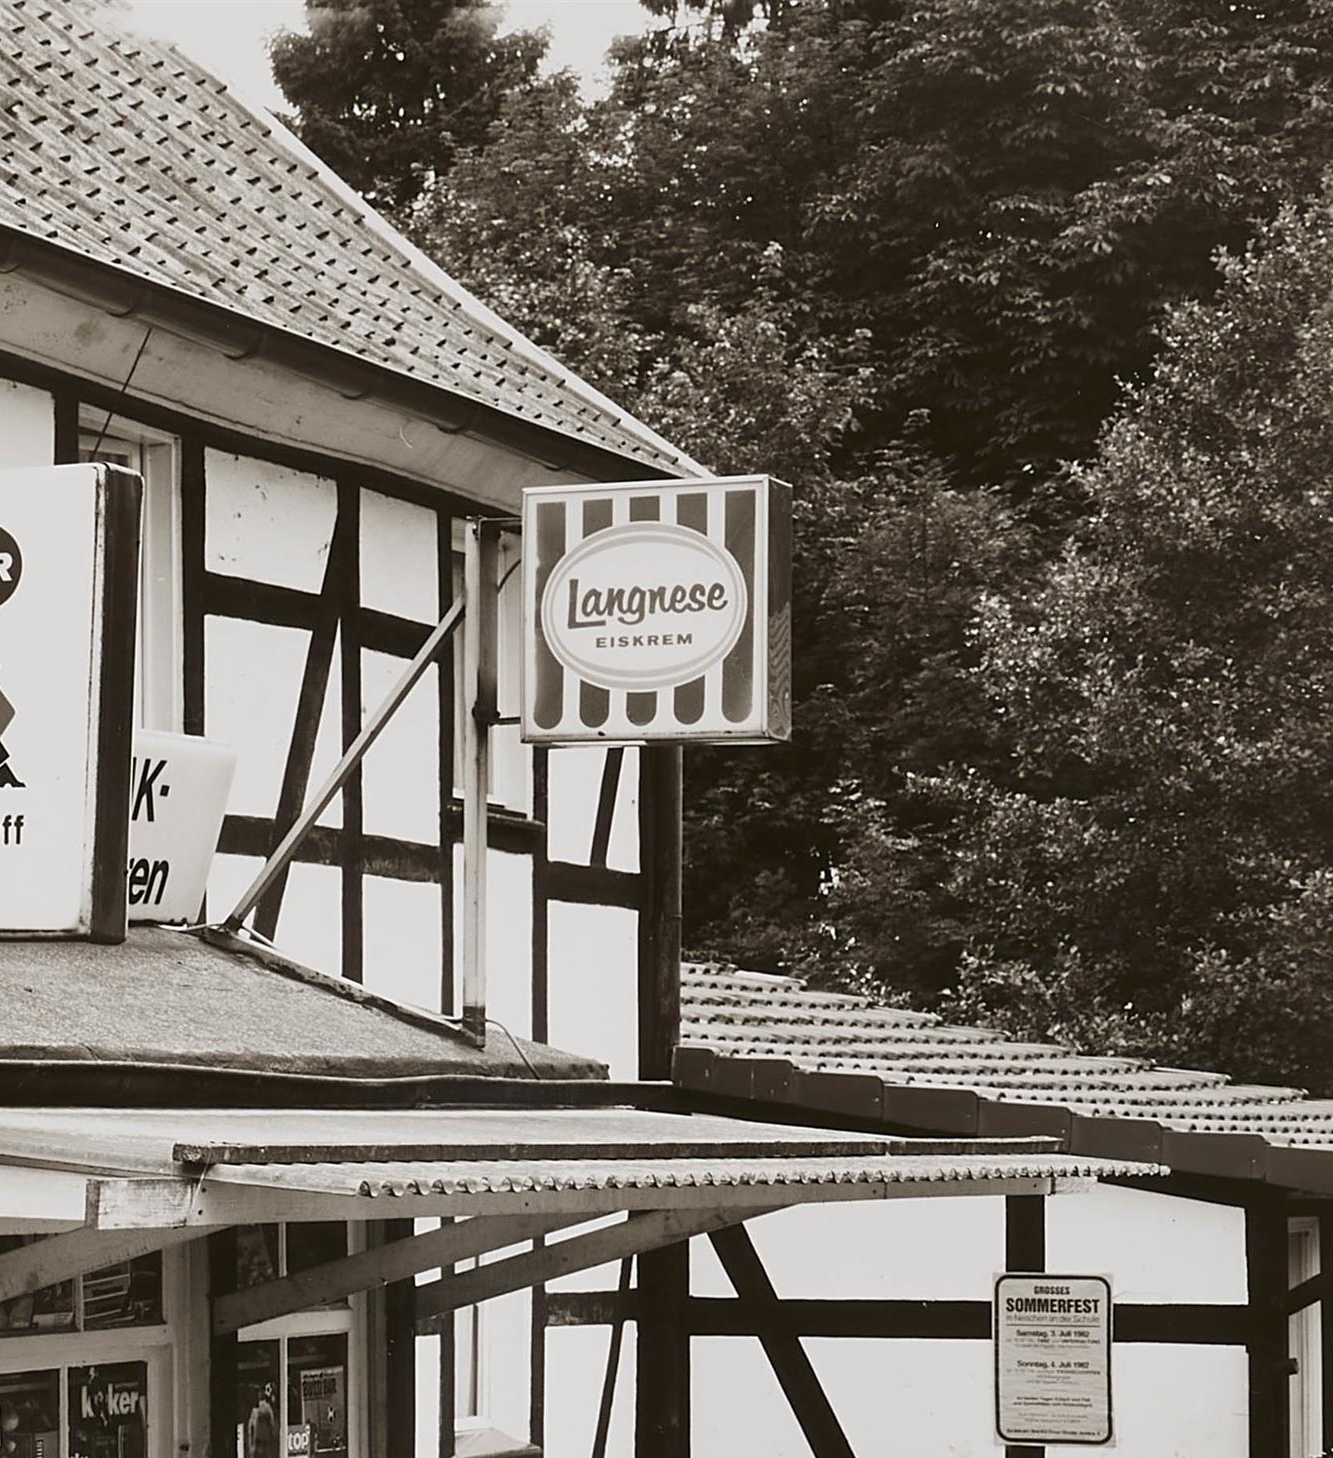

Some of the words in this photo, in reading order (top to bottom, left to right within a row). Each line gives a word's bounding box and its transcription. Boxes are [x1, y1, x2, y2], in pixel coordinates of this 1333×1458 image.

[568, 579, 728, 629] Langnese
[596, 634, 693, 648] EISKREM
[1034, 1286, 1070, 1295] GROSSES
[1006, 1298, 1100, 1314] SOMMERFEST
